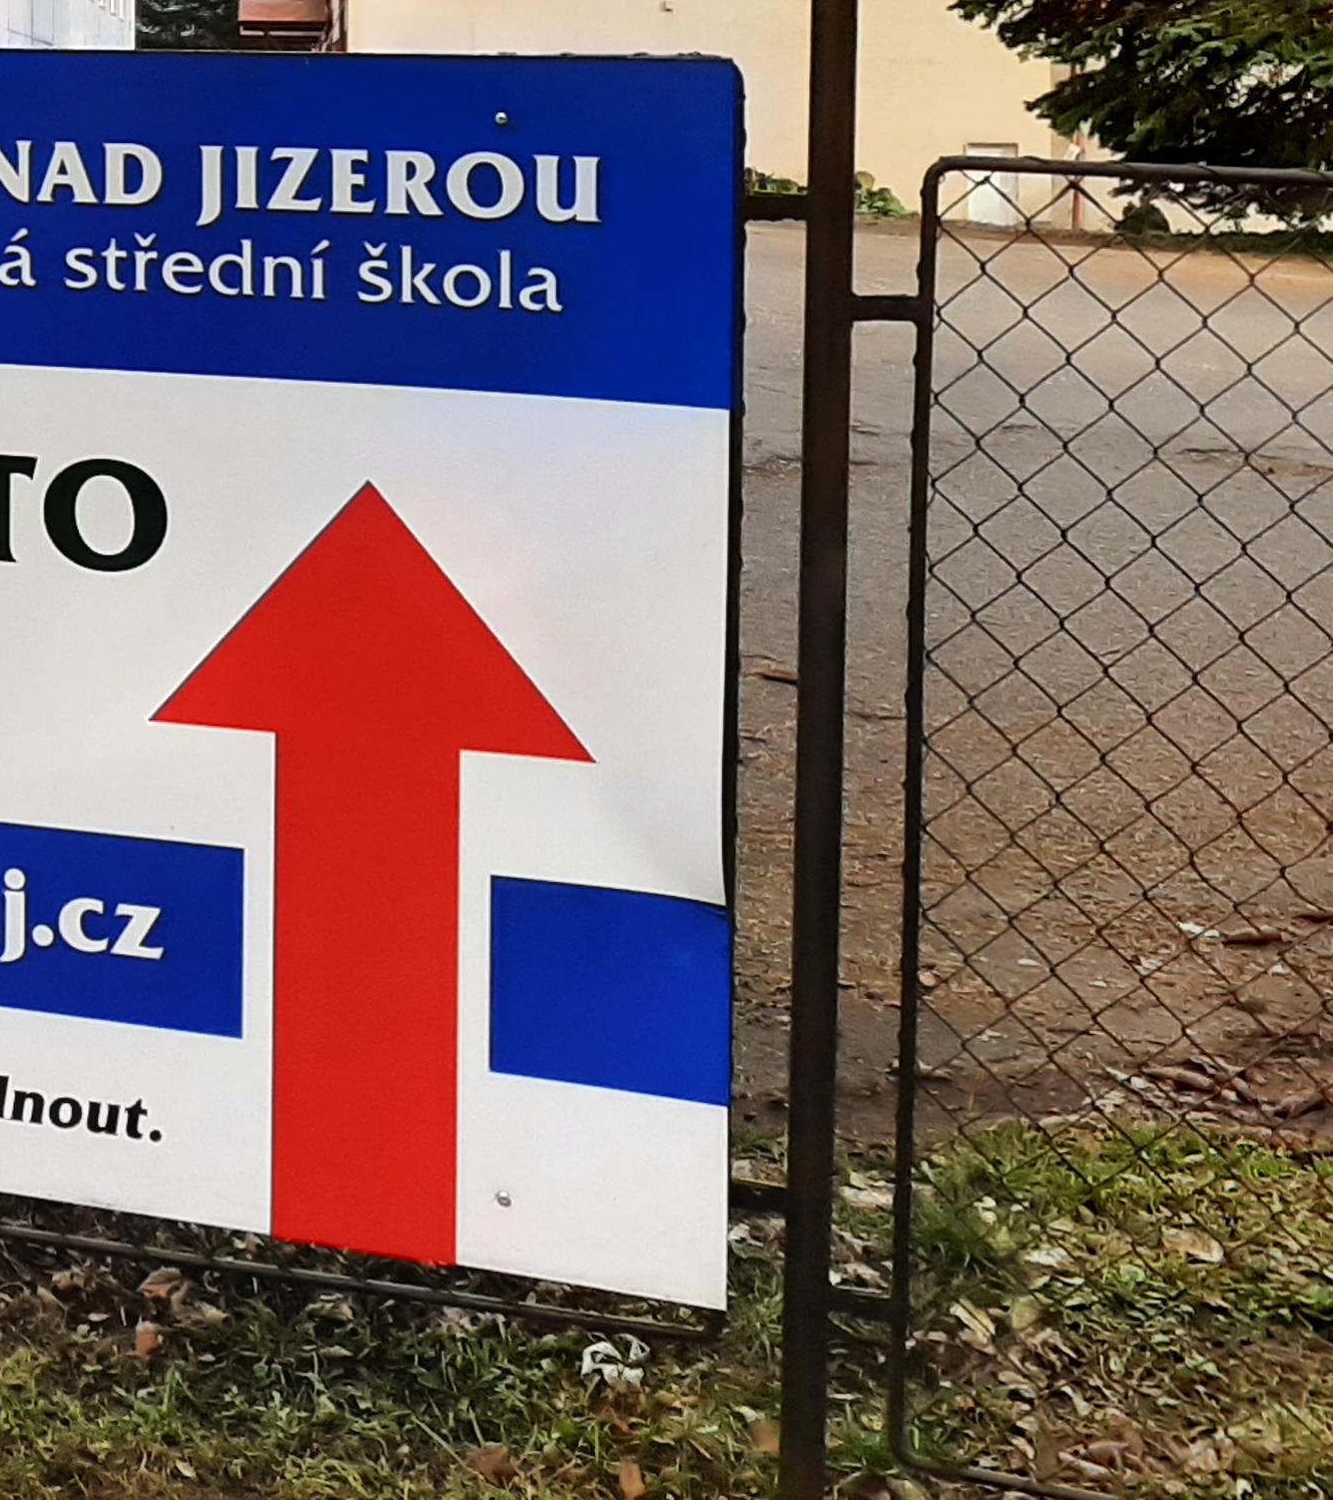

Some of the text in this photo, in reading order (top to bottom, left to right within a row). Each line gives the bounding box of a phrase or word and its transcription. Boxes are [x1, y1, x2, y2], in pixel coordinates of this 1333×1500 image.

[195, 144, 601, 227] JIZEROU
[64, 232, 331, 301] střední
[357, 242, 564, 313] škola
